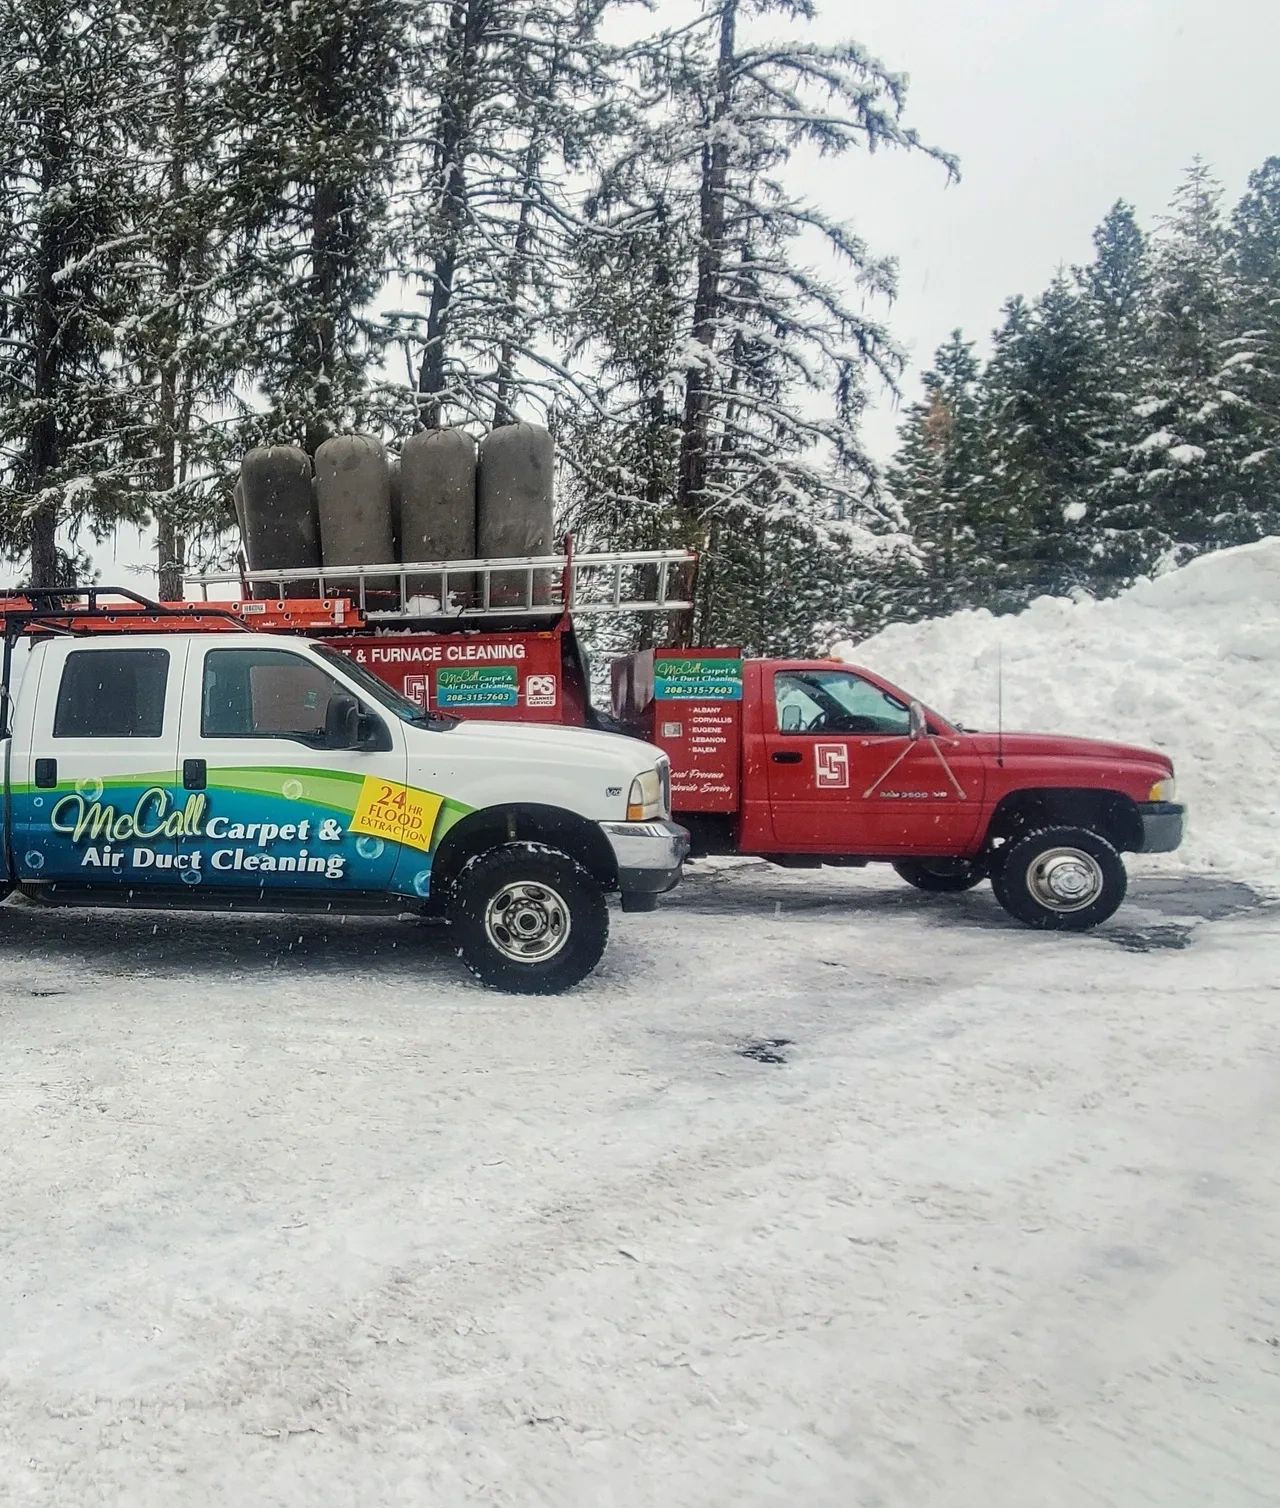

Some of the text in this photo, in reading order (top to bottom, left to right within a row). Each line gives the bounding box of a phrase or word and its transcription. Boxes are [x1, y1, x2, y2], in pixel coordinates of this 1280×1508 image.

[356, 644, 525, 663] & FURNACE CLEANING
[439, 669, 480, 684] McCall
[479, 675, 505, 684] Carpet
[658, 661, 701, 675] McCall
[528, 676, 554, 695] PS
[446, 693, 509, 701] 208-315-7603
[377, 786, 423, 816] 24 HR
[50, 787, 343, 847] McCall Carpet &
[368, 804, 423, 829] FLOOD
[360, 816, 427, 843] EXTRACTION
[81, 845, 346, 879] Air Duct Cleaning
